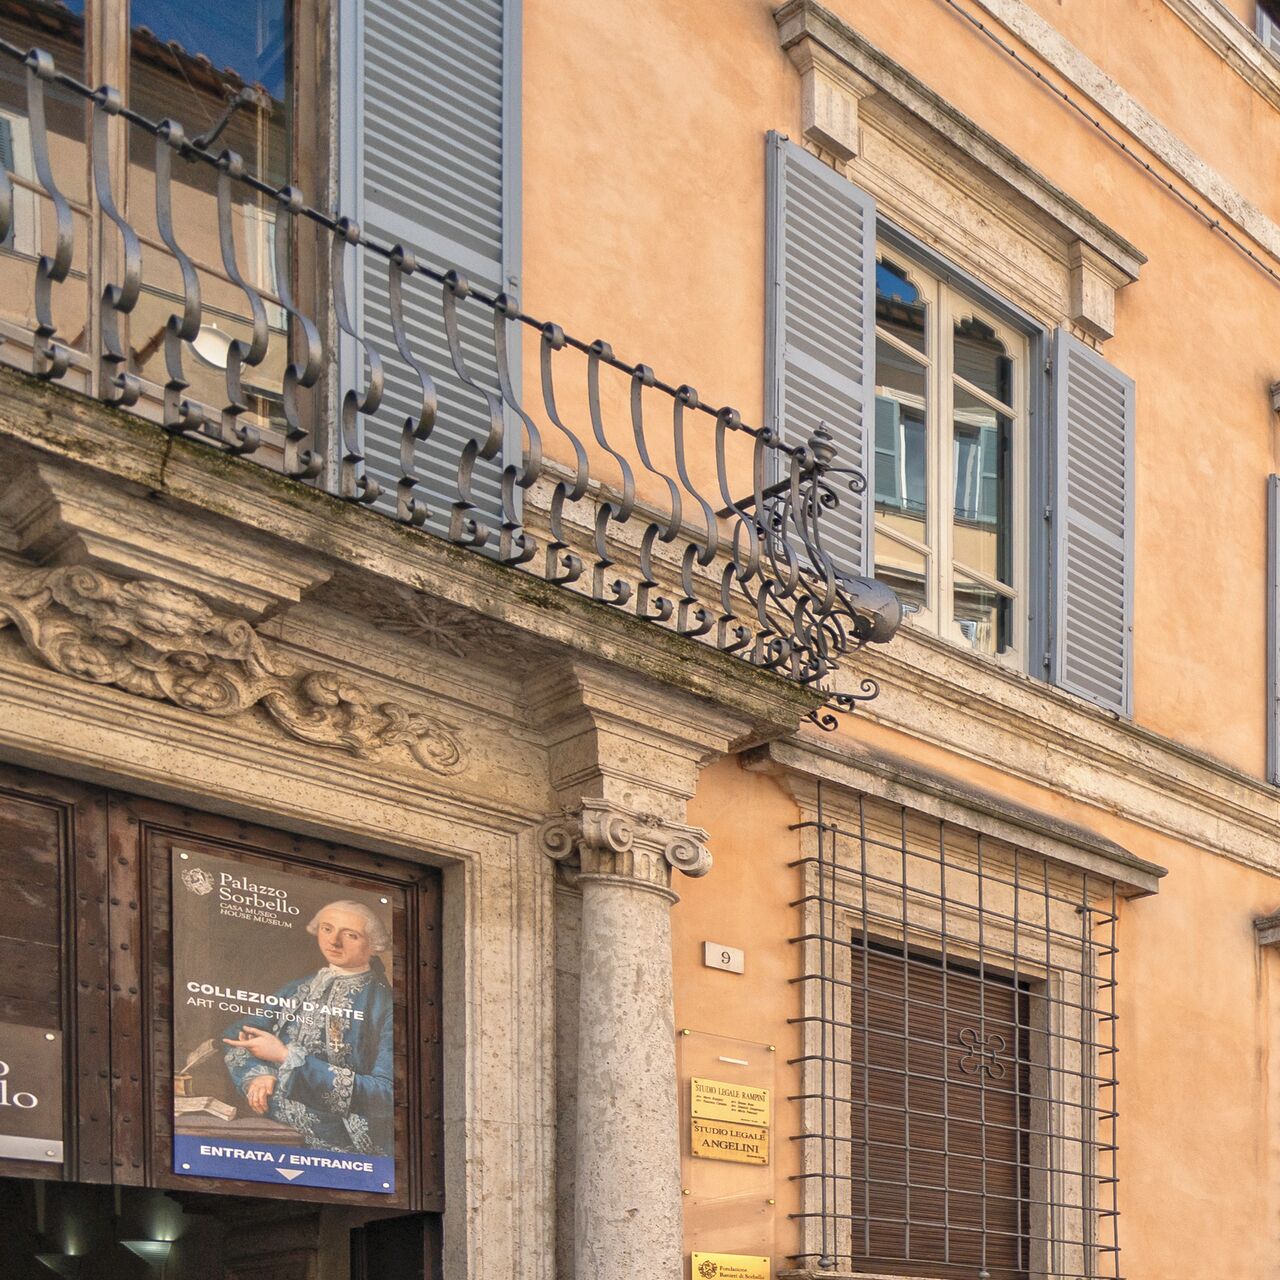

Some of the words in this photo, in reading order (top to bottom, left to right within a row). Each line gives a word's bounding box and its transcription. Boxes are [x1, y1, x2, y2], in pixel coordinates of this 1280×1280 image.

[219, 872, 288, 899] Palazzo
[219, 887, 300, 916] Sorbello
[220, 902, 243, 914] CASA
[245, 907, 277, 919] MUSEO
[220, 909, 252, 921] HOUSE
[253, 914, 293, 929] MUSEUM
[721, 951, 731, 965] 9
[186, 981, 296, 1010] COLLEZIONI
[302, 1000, 365, 1021] D'ARTE
[186, 996, 214, 1009] ART
[218, 1001, 315, 1026] COLLECTIONS
[695, 1084, 717, 1094] STUDIO
[718, 1088, 740, 1099] LEGALE
[742, 1091, 766, 1103] RAMPINI
[694, 1125, 729, 1136] STUDIO
[730, 1130, 766, 1142] LEGALE
[701, 1139, 760, 1154] ANGELINI
[200, 1145, 275, 1162] ENTRATA
[289, 1154, 374, 1172] ENTRANCE
